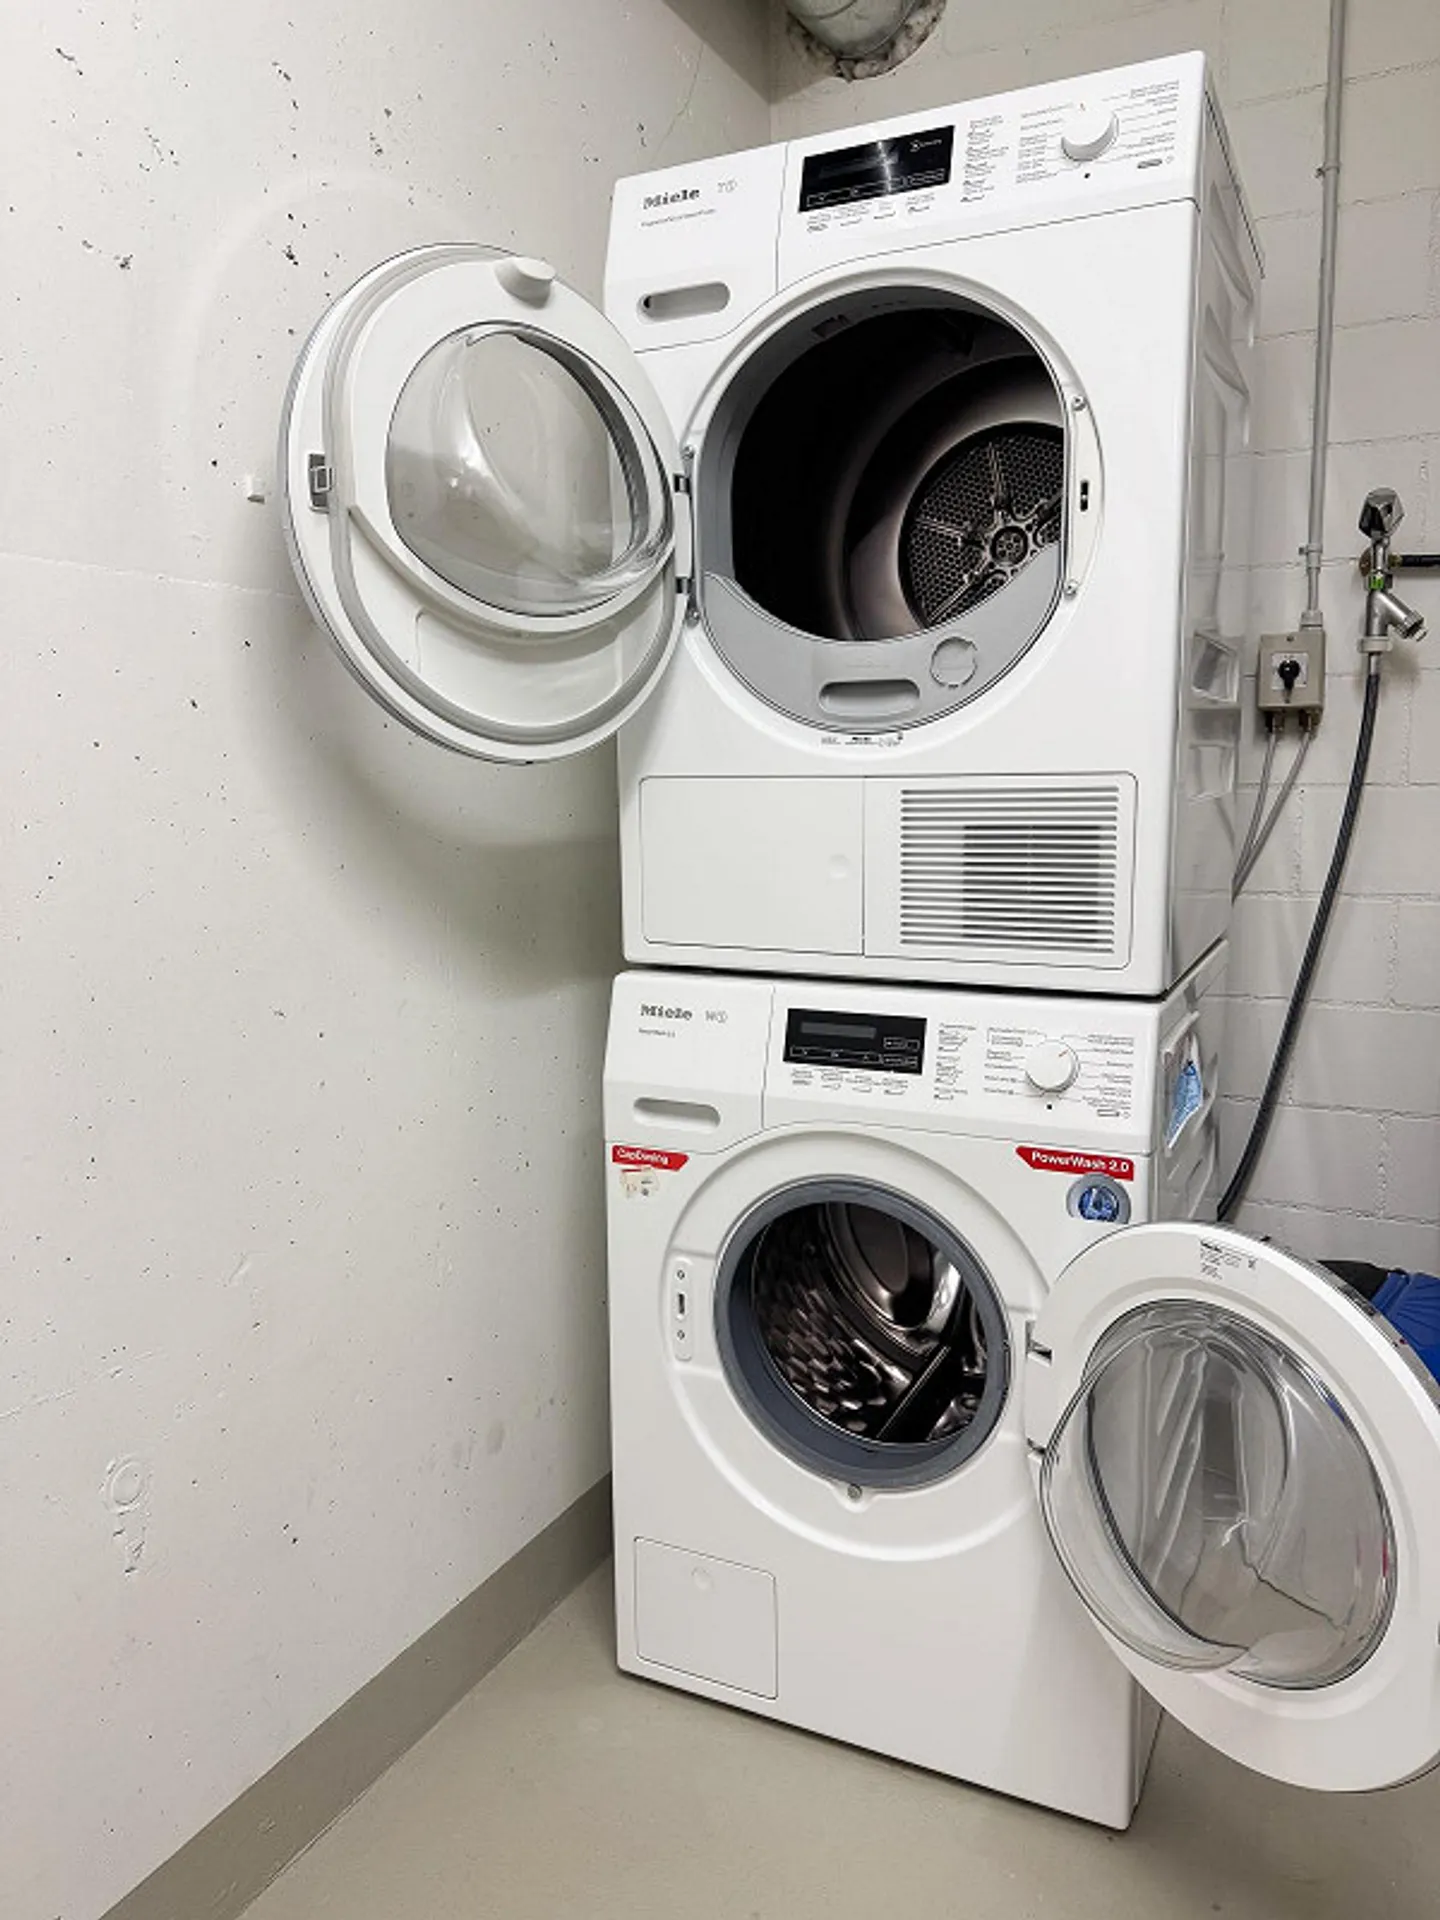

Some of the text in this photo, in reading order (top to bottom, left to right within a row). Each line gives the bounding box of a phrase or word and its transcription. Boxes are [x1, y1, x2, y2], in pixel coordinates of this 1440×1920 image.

[643, 189, 700, 209] Miele
[641, 1004, 693, 1021] Miele
[1031, 1151, 1130, 1172] PowerWash 2.0
